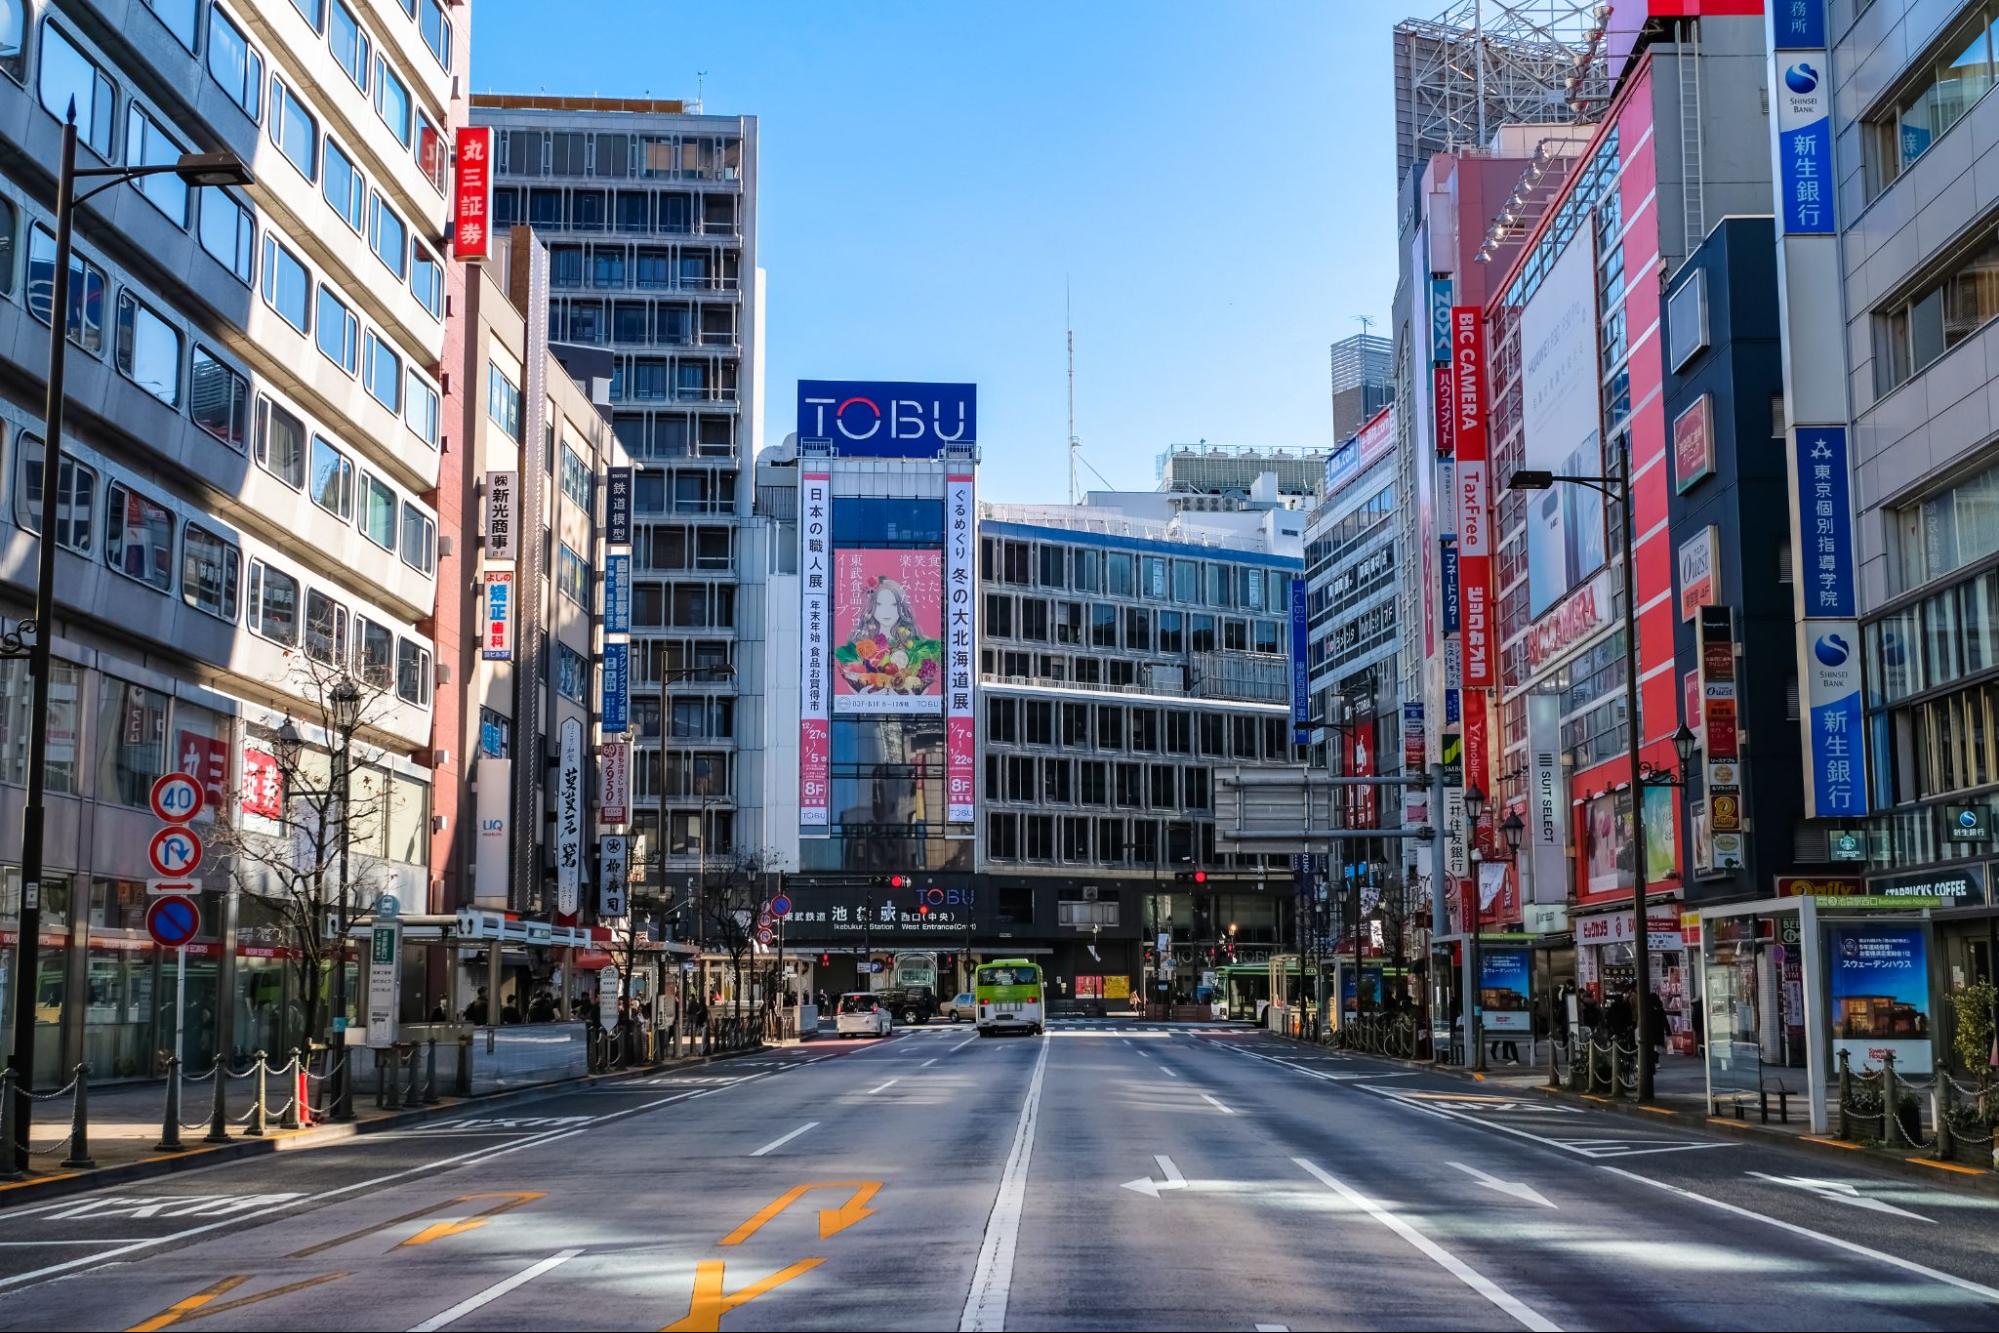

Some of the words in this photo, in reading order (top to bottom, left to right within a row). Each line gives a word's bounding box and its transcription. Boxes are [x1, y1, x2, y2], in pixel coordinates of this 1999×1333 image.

[1790, 97, 1818, 105] SHINSEI
[1793, 105, 1814, 113] BANK
[460, 140, 484, 245] 丸三証券
[1793, 134, 1820, 226] 新生銀行
[1459, 313, 1474, 344] BIC
[1440, 373, 1451, 443] ハウスメイト
[1460, 350, 1477, 431] CAMERA
[805, 397, 965, 440] TOBU
[612, 482, 626, 541] 鉄道模型
[954, 489, 967, 559] ぐるめぐり
[809, 488, 823, 588] 日本の職人展
[1814, 465, 1838, 607] 東京個別指導学院
[486, 574, 511, 582] よしの
[810, 600, 821, 643] 年末年始
[952, 567, 969, 710] 冬の大北海道展
[1467, 586, 1486, 679] ビックカメラ
[810, 647, 821, 711] 食品お買得市
[1819, 671, 1848, 679] SHINSEI
[1823, 679, 1844, 687] BANK
[605, 759, 615, 802] 2950
[1823, 710, 1851, 808] 新生銀行
[163, 788, 192, 809] 40
[804, 783, 824, 796] 8F
[951, 779, 970, 791] 8F
[1541, 771, 1551, 796] SUIT
[483, 819, 503, 832] UQ
[1450, 791, 1463, 872] 三井住友銀行
[1542, 799, 1553, 843] SELECT
[1953, 828, 1985, 838] 新生銀行
[915, 888, 976, 905] TOBU
[1934, 879, 1967, 896] COFFEE
[784, 911, 826, 922] 東武鉄道
[1842, 959, 1912, 969] スウェーデンハウス
